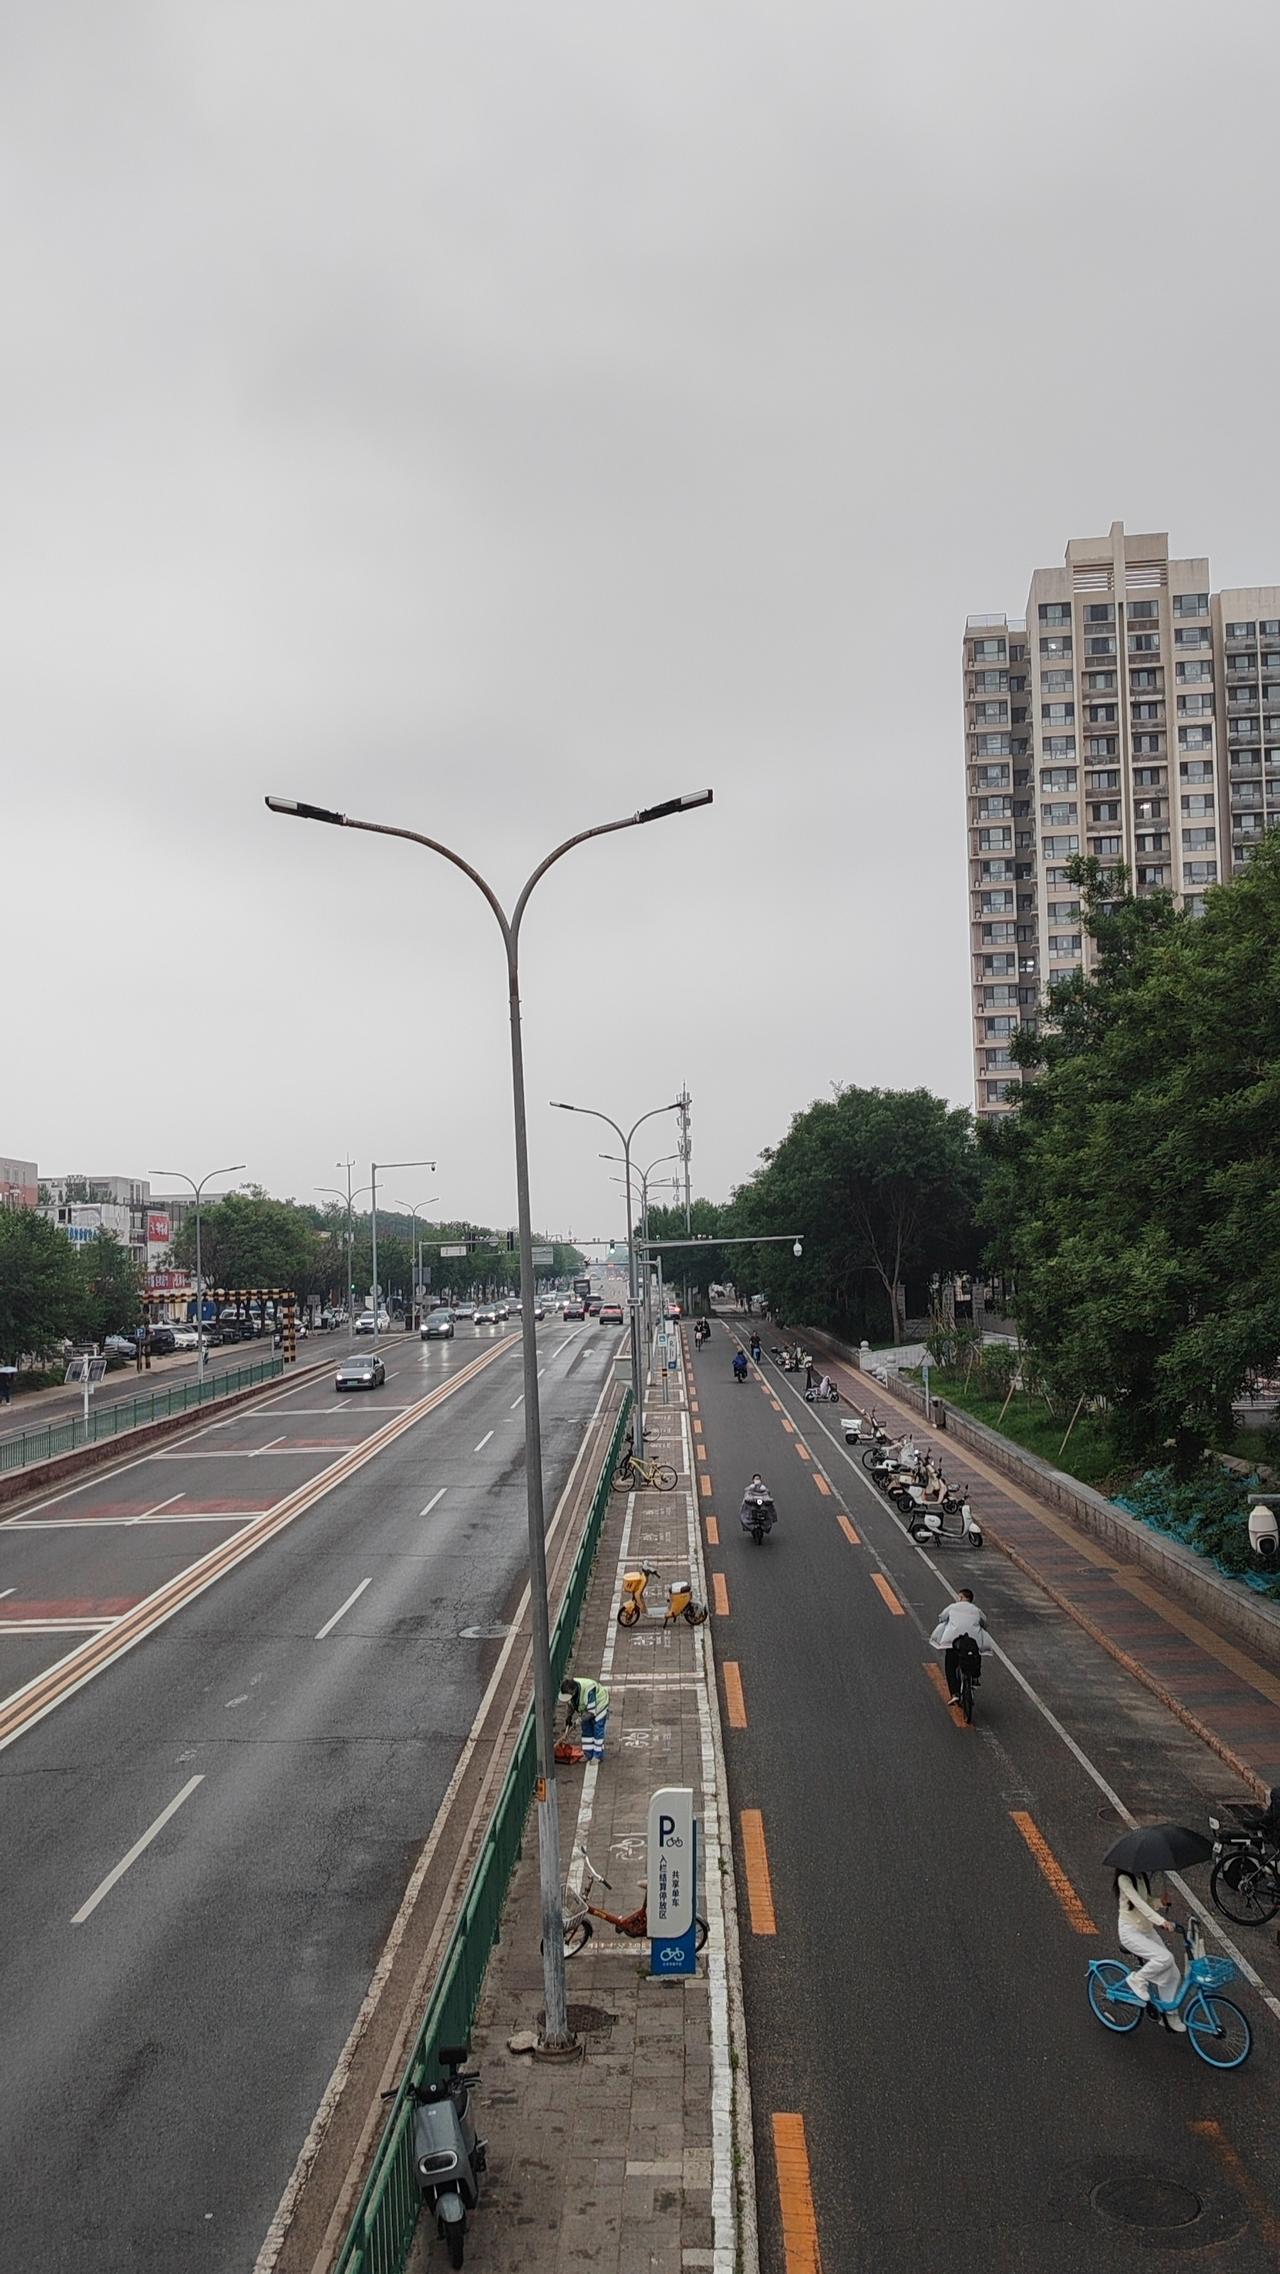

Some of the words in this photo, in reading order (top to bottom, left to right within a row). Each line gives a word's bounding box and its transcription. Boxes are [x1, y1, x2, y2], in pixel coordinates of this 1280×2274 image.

[659, 1815, 676, 1848] P
[659, 1855, 668, 1919] 入栏结算停放区
[672, 1870, 680, 1907] 共享单车
